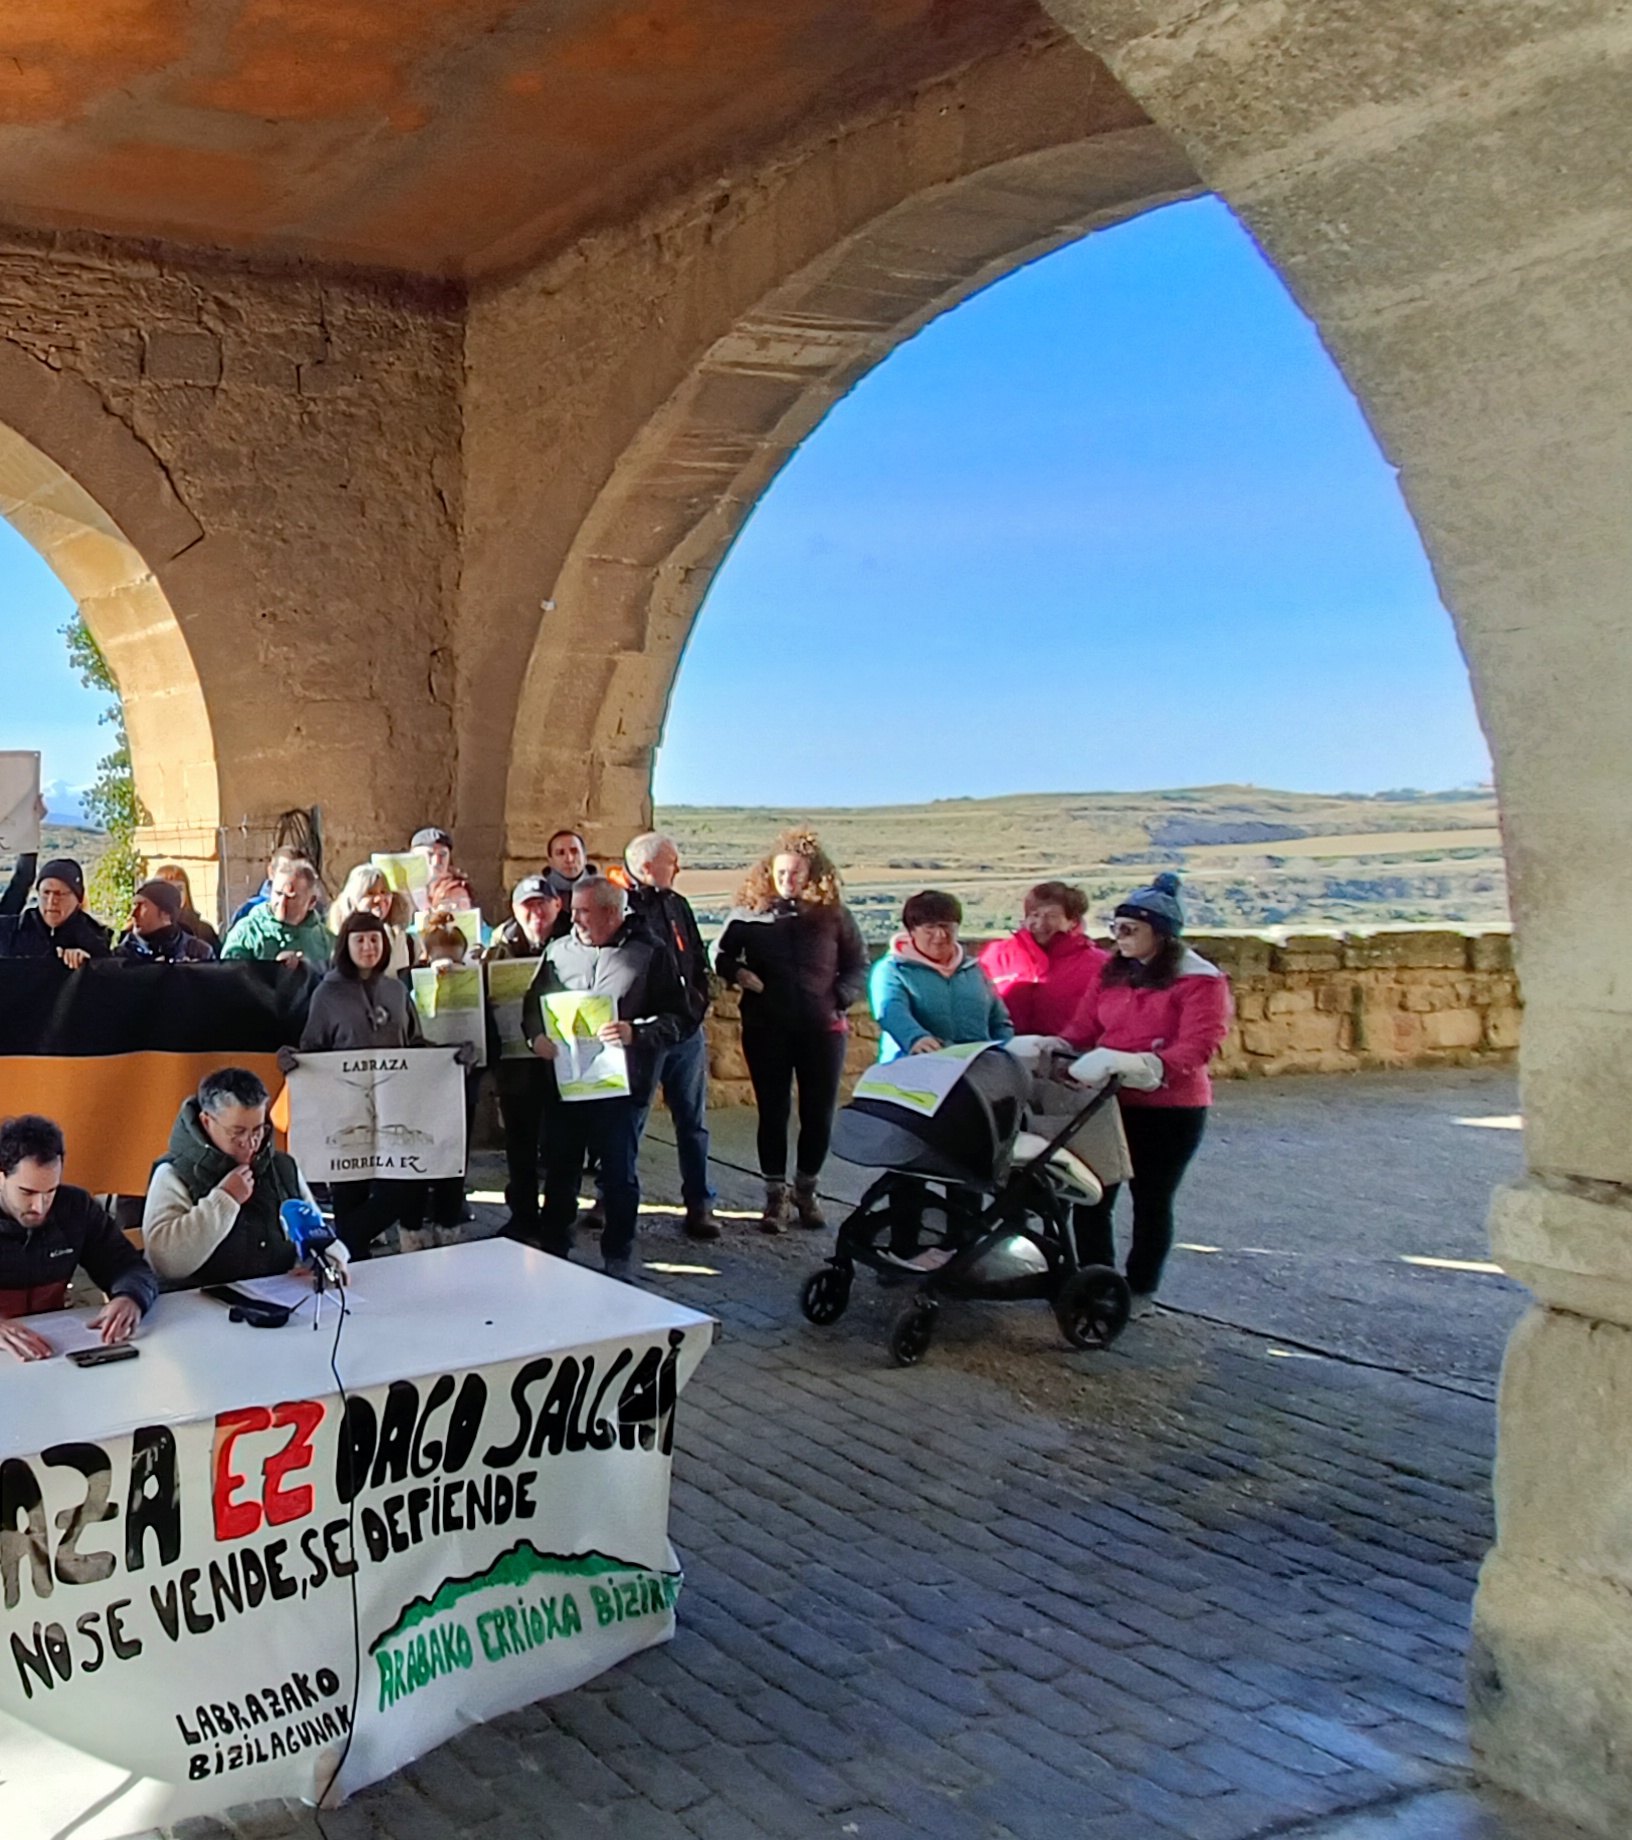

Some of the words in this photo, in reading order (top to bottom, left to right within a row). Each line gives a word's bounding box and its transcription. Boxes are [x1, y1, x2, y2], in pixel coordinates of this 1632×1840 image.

[342, 1059, 409, 1073] LABRAZA
[330, 1156, 395, 1171] HORRELA
[400, 1156, 428, 1174] EZ
[211, 1399, 325, 1542] EZ
[335, 1372, 488, 1505] DAGO
[175, 1667, 340, 1746] LABRAZAKO
[375, 1621, 474, 1713] ARABAKO
